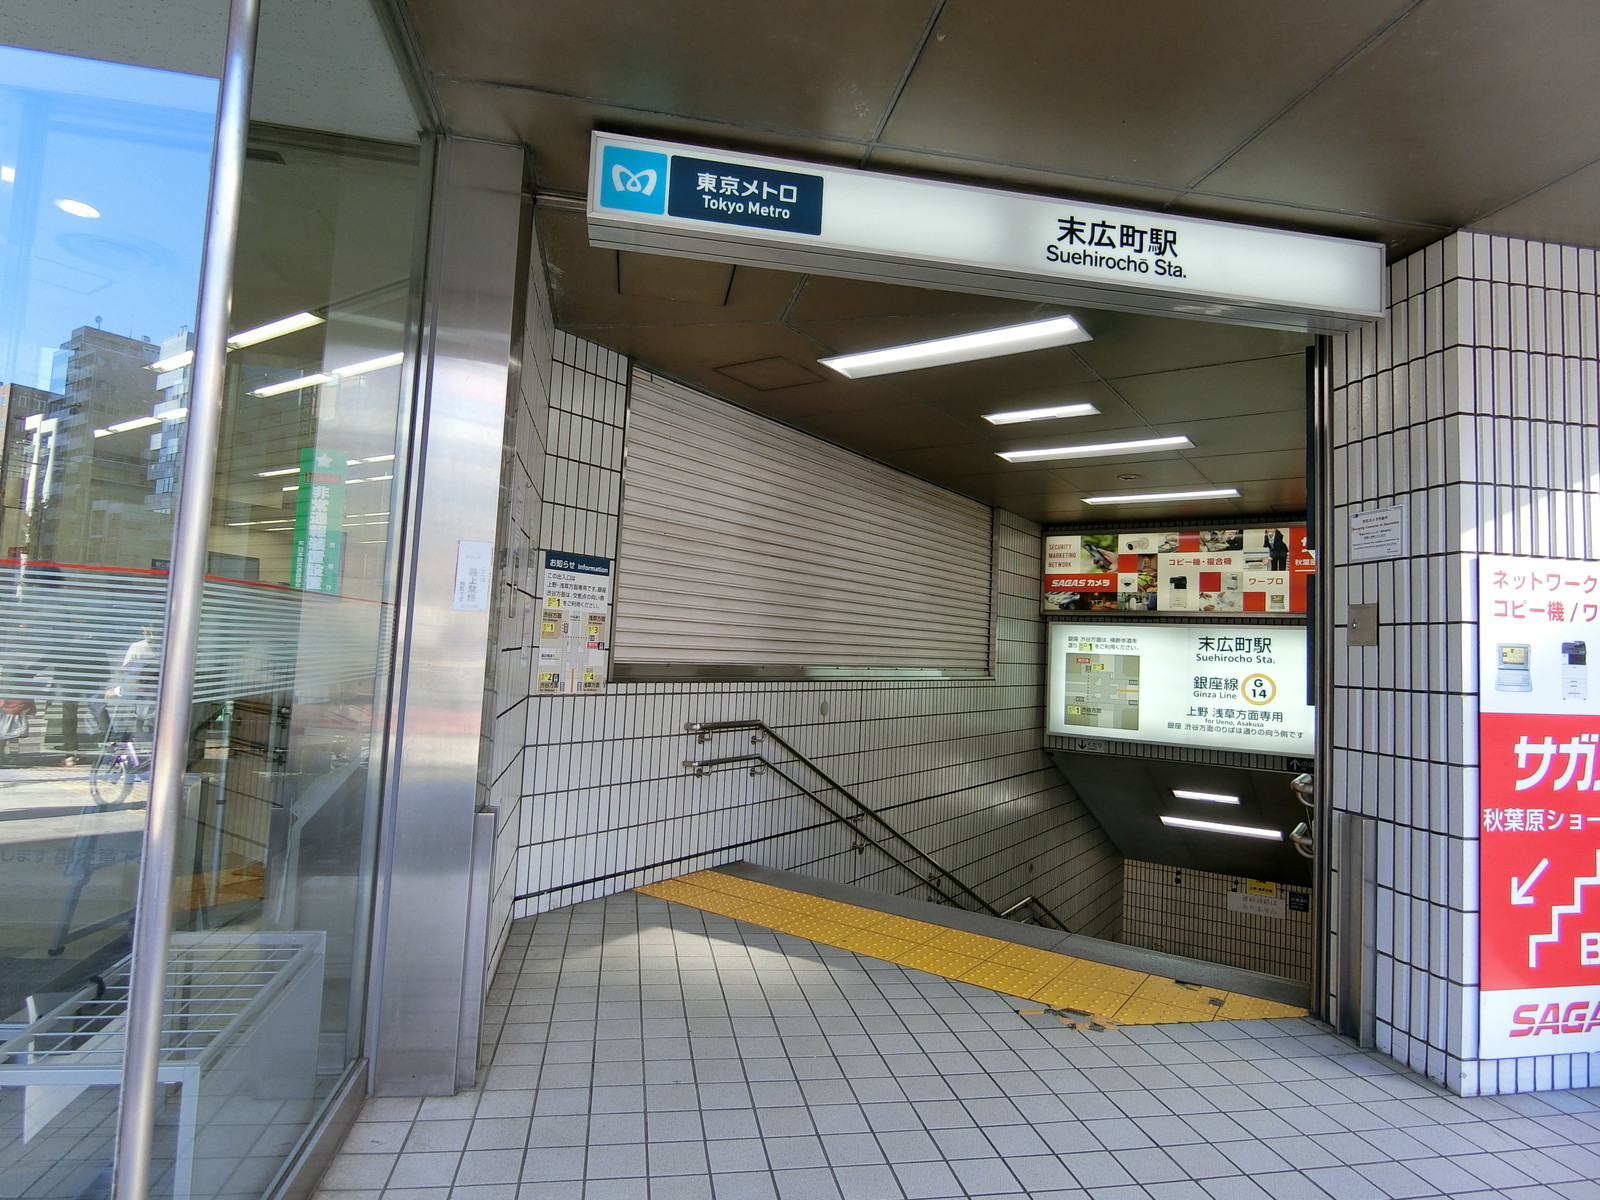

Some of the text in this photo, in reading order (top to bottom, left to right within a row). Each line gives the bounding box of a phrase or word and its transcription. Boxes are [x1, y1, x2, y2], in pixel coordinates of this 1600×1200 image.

[696, 172, 797, 204] 東京メトロ
[702, 194, 791, 219] Tokyo Metro
[1057, 216, 1178, 258] 末広町駅
[1046, 244, 1187, 279] Suehirochō Sta.
[1049, 543, 1072, 551] SECURITY
[549, 558, 608, 574] お知らせ Information
[1051, 579, 1110, 587] SAGAS カメラ
[1492, 569, 1598, 594] ネットワーク
[556, 598, 560, 607] 1
[594, 626, 598, 634] 3
[1088, 643, 1093, 651] 1
[1198, 636, 1272, 654] 末広町駅
[1256, 655, 1275, 664] Sta.
[1100, 663, 1105, 671] 3
[1193, 675, 1239, 691] 銀座線
[1254, 679, 1263, 688] G
[1193, 690, 1237, 700] Ginza Line
[1251, 689, 1267, 699] 14
[1186, 705, 1284, 723] 上野 浅草方面専用
[1167, 722, 1182, 730] 銀座
[1236, 720, 1264, 728] Asakusa
[1513, 732, 1600, 792] サガ
[1482, 807, 1600, 833] 秋葉原ショー
[1581, 932, 1600, 966] B
